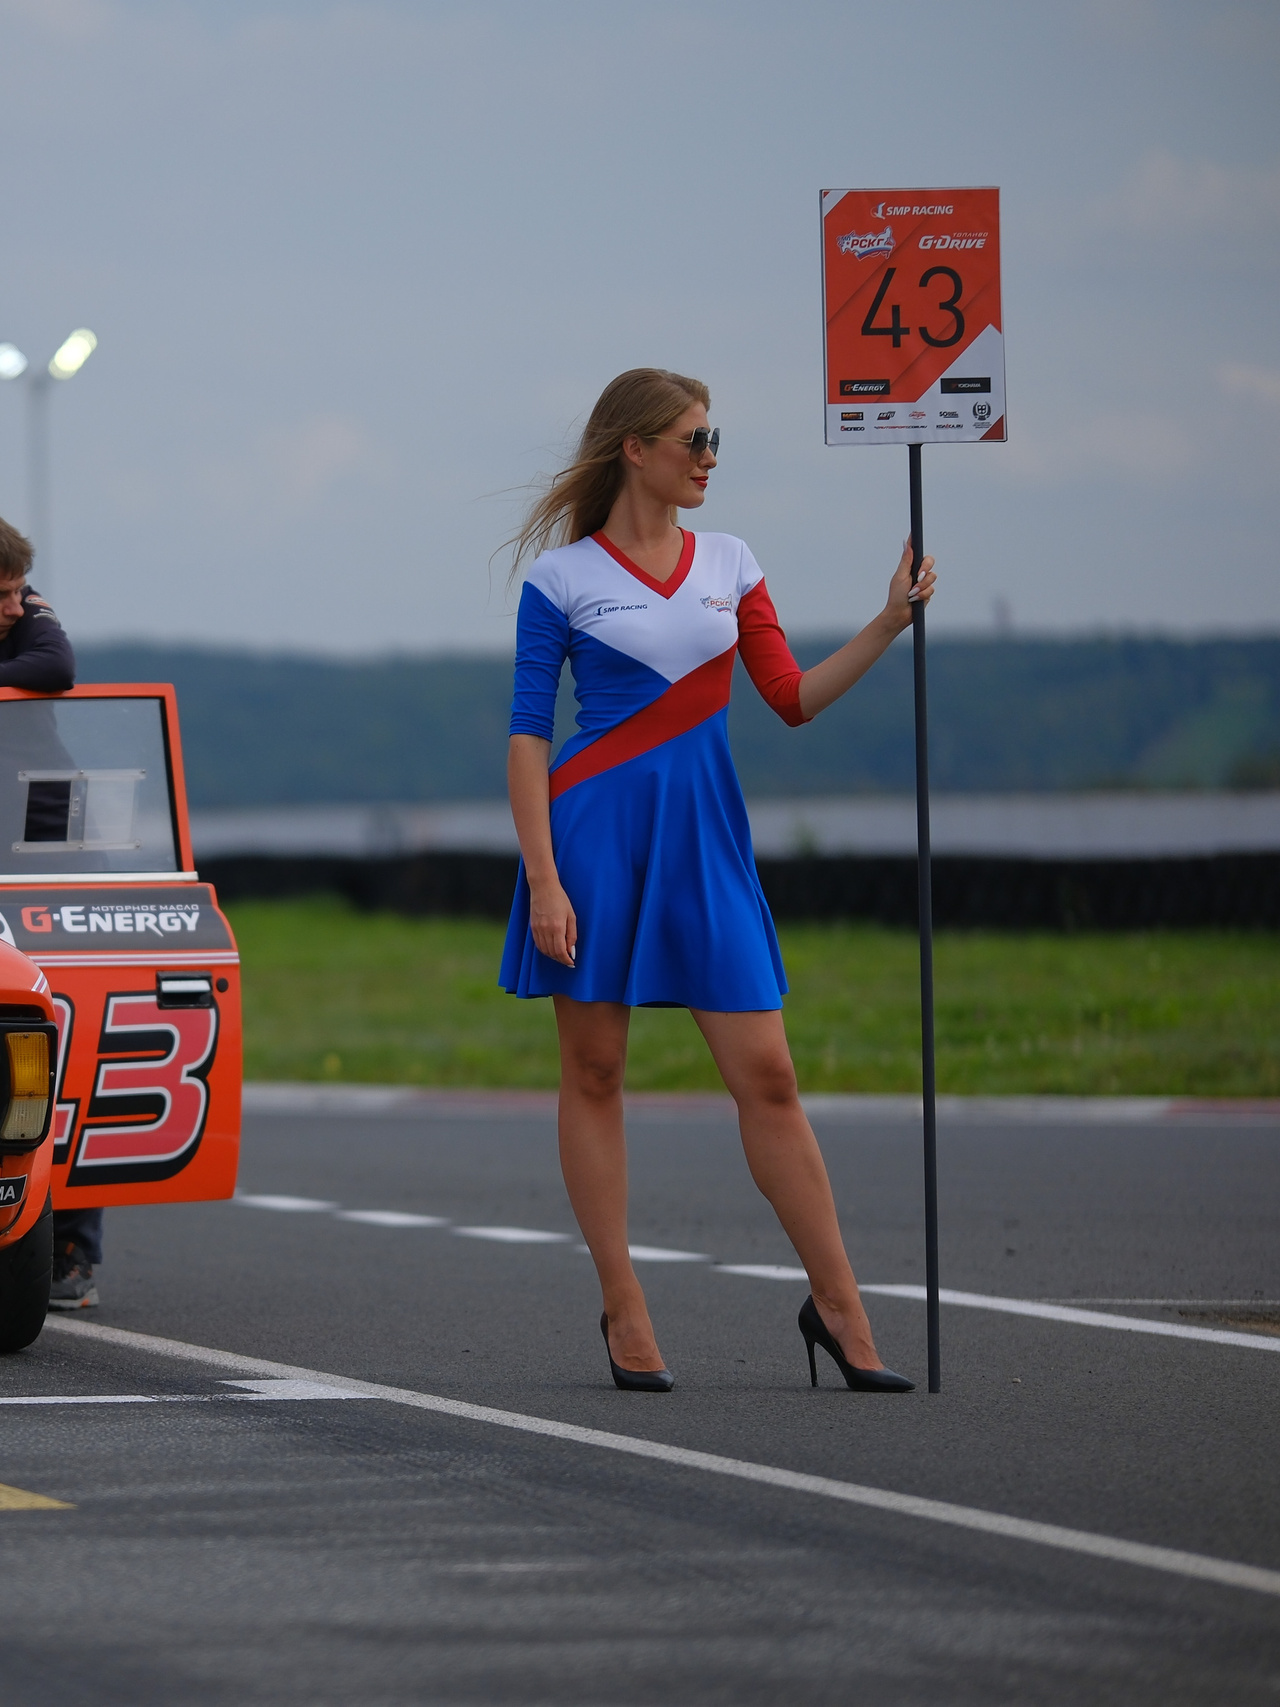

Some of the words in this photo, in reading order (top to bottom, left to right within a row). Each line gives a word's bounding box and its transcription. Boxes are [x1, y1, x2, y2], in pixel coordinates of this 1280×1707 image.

[886, 205, 911, 216] SMP
[912, 205, 954, 215] RACING
[861, 265, 965, 348] 43
[603, 606, 619, 614] SMP
[91, 904, 157, 912] МОТОРНОЕ
[161, 903, 200, 911] МАСЛО
